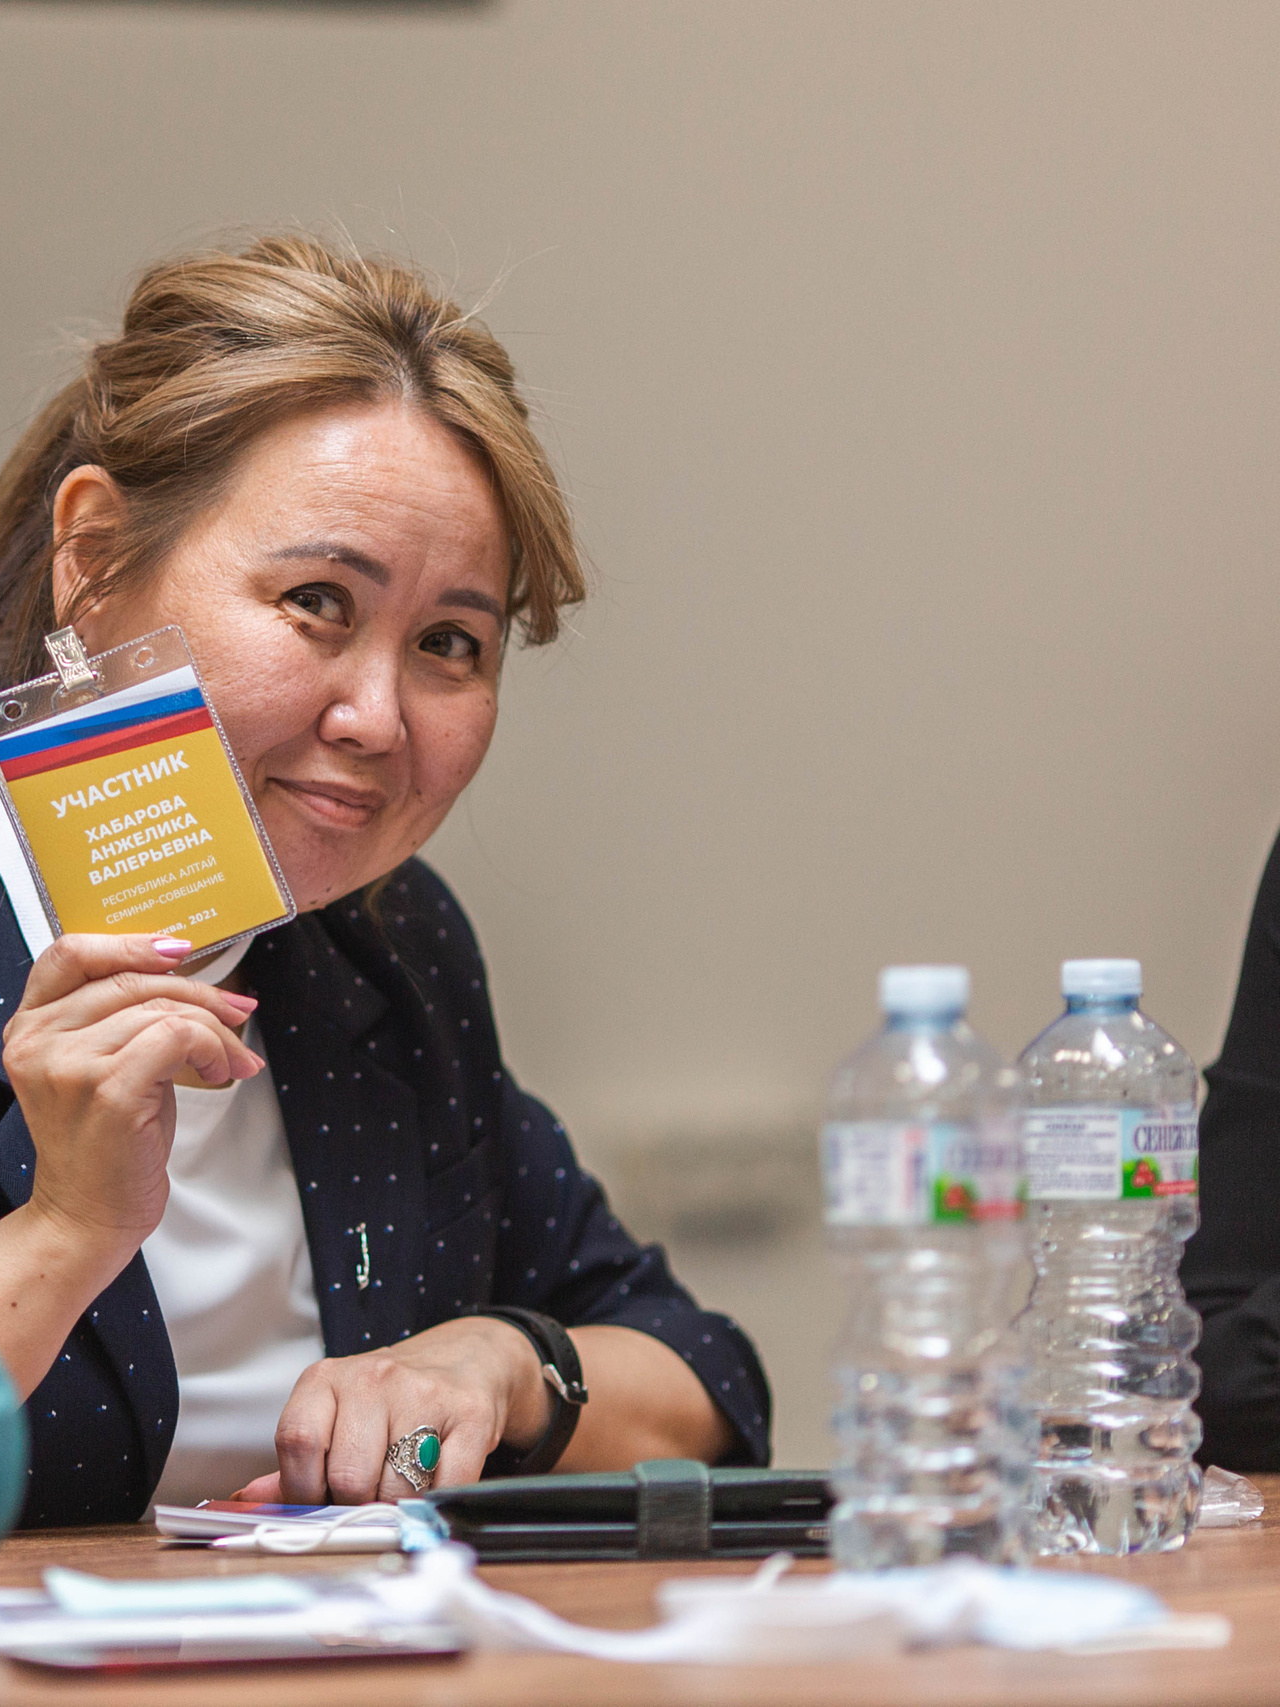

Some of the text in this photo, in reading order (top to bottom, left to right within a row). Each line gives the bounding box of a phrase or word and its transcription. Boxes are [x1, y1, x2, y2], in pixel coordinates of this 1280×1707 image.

[50, 750, 189, 818] УЧАСТНИК
[84, 795, 187, 843] ХАБАРОВА
[91, 812, 198, 864] АНЖЕЛИКА
[88, 828, 213, 885] ВАЛЕРЬЕВНА
[101, 854, 217, 907] РЕСПУБЛИКА АЛТАЙ
[105, 872, 226, 925] СЕМИНАР-СОВЕЩАНИЕ
[151, 907, 218, 936] сква, 2021
